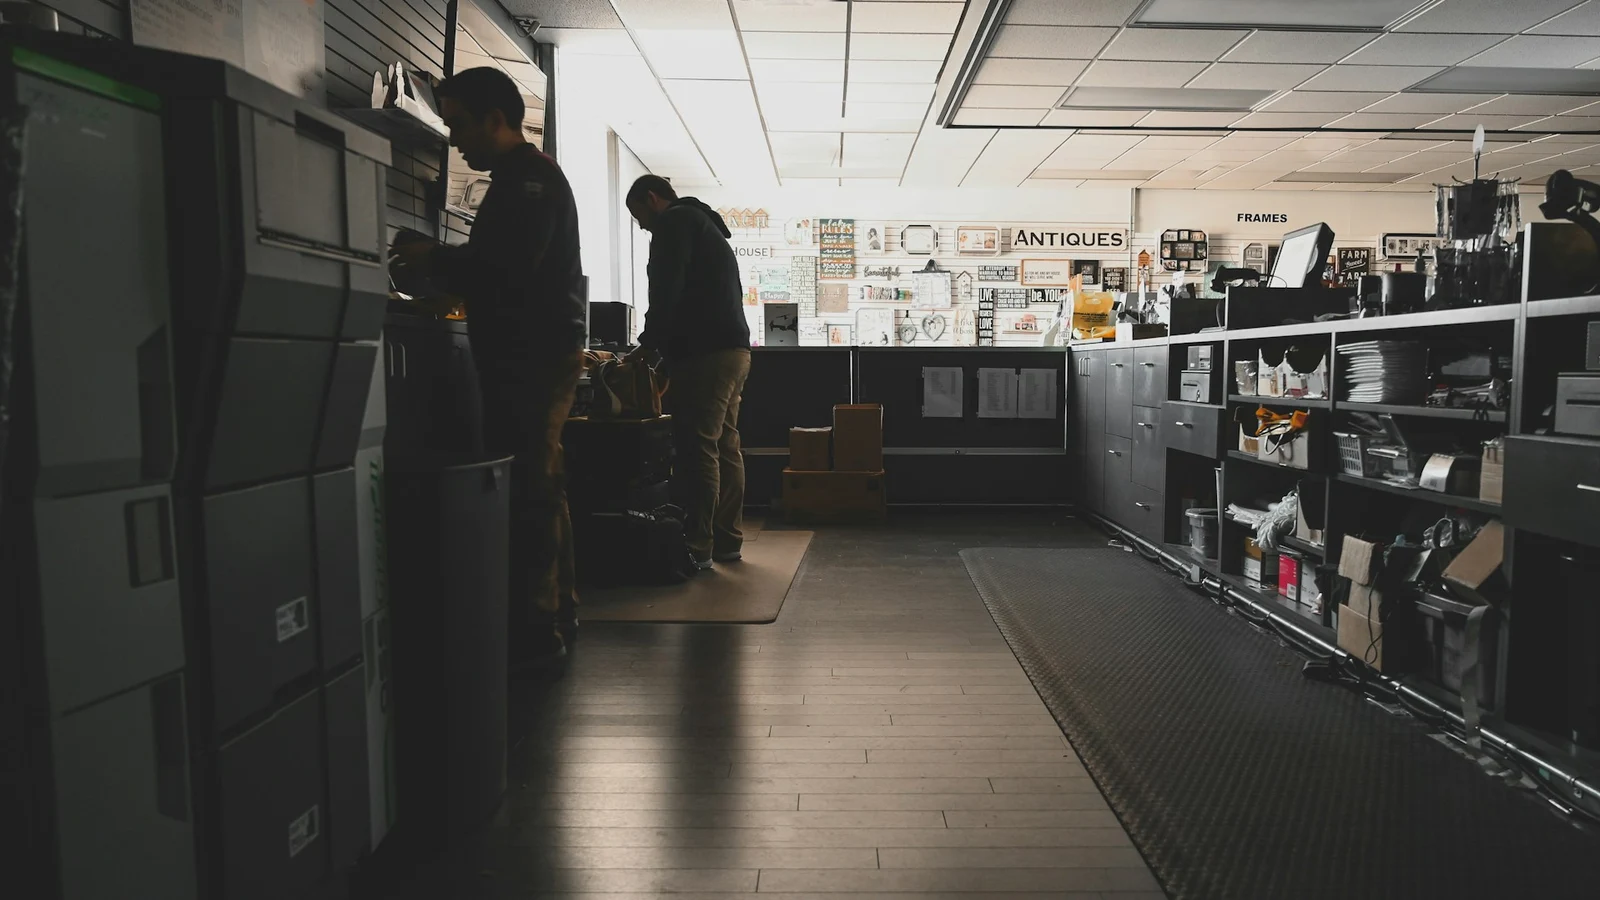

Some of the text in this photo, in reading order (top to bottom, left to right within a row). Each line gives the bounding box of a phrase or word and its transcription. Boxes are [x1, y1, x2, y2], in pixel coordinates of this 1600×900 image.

[1237, 213, 1288, 223] FRAMES
[821, 223, 853, 235] RULES
[1014, 229, 1123, 247] ANTIQUES
[1341, 250, 1368, 259] FARM
[1341, 271, 1367, 280] ARM
[979, 288, 994, 302] LIVE
[979, 317, 993, 330] LOVE
